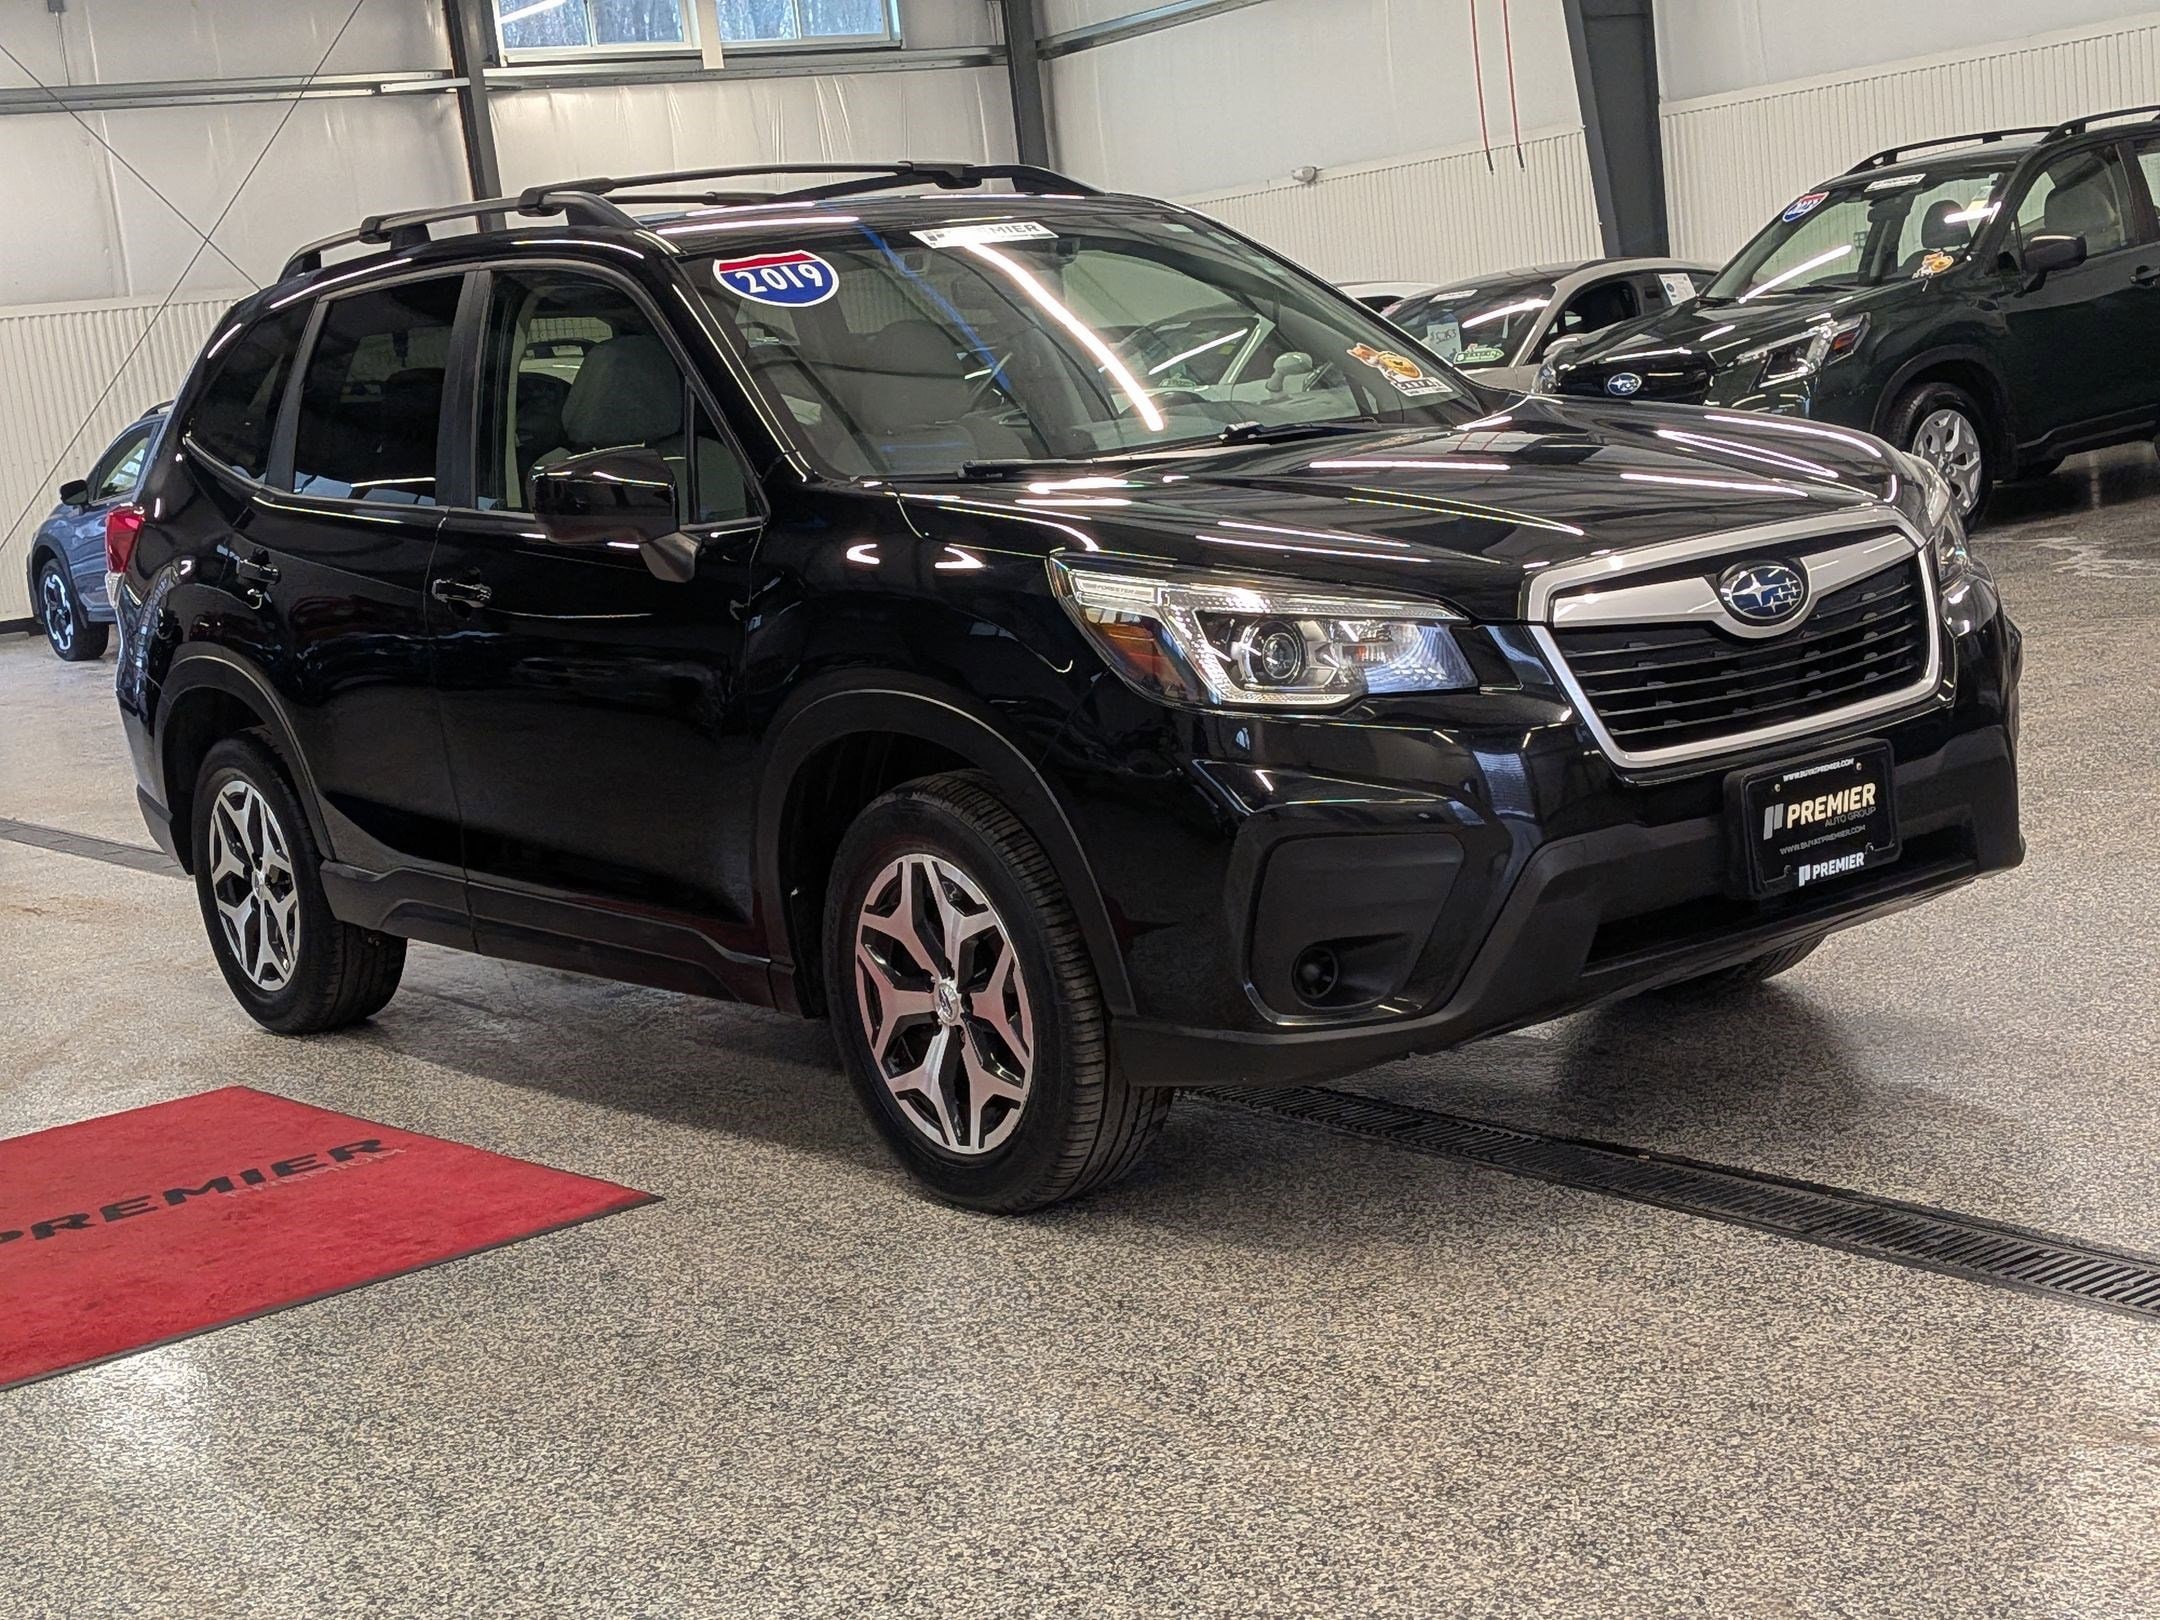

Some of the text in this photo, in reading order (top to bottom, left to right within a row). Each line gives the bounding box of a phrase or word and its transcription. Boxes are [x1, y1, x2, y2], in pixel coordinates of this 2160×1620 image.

[734, 262, 824, 294] 2019
[1786, 782, 1876, 829] PREMIER
[1824, 806, 1877, 828] AUTO GROUP
[1812, 851, 1865, 879] PREMIER
